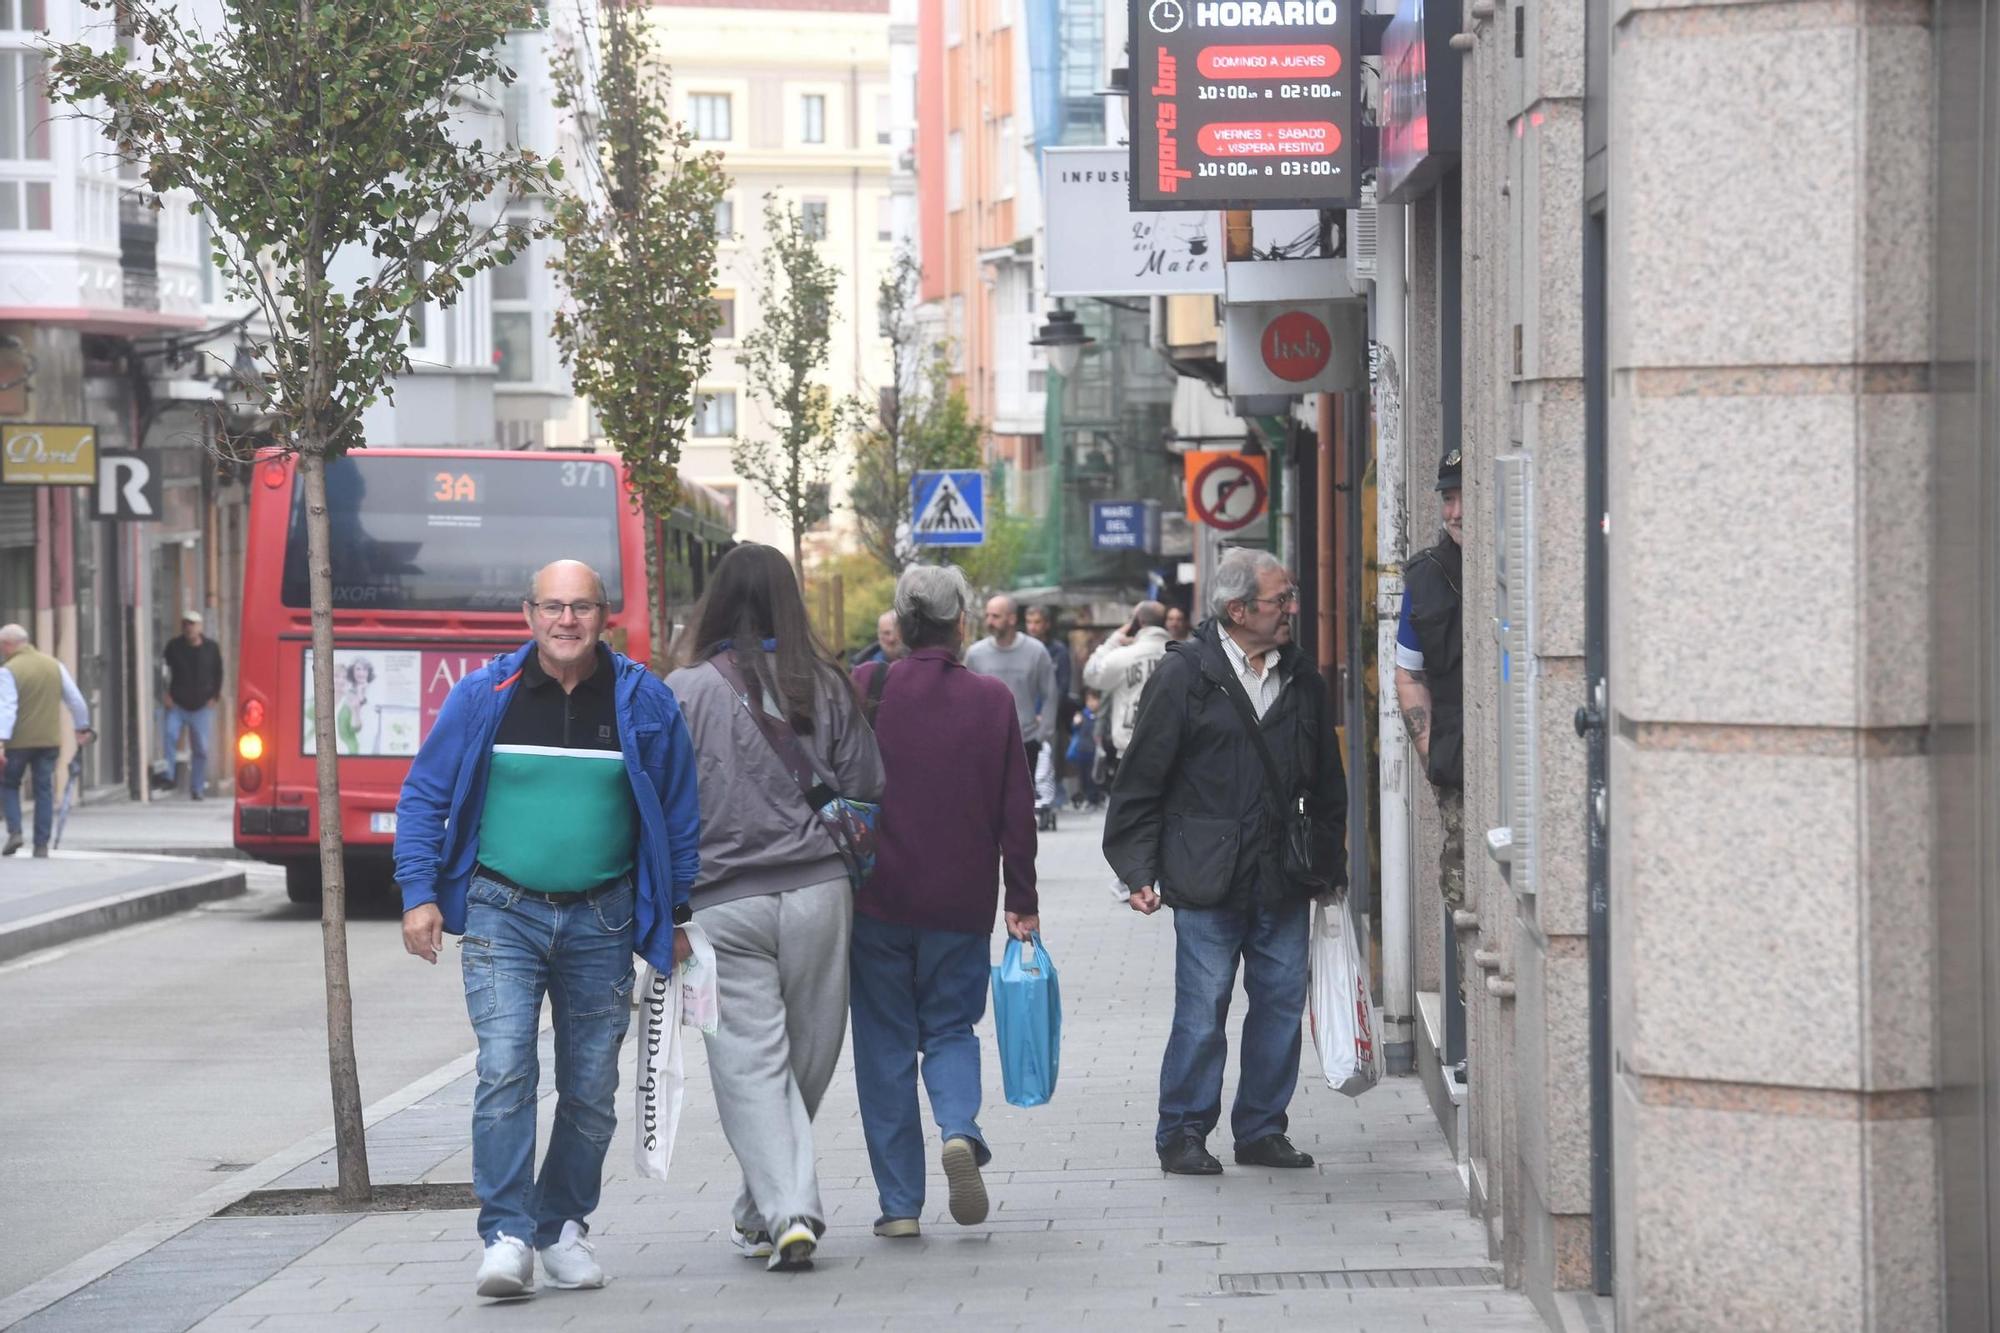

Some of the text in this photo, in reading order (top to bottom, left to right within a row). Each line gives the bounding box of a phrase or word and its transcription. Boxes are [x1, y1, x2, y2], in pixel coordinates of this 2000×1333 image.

[1197, 0, 1337, 26] HORARIO
[1212, 55, 1326, 68] DOMINGO A JUEVES
[1264, 89, 1273, 98] a
[1152, 46, 1192, 193] sports bar
[1214, 129, 1262, 140] VIERNES
[1278, 141, 1325, 153] FESTIVO
[1264, 165, 1273, 176] a
[1135, 249, 1210, 277] Mate
[98, 455, 153, 515] R
[434, 472, 476, 502] 3A
[561, 461, 608, 487] 371
